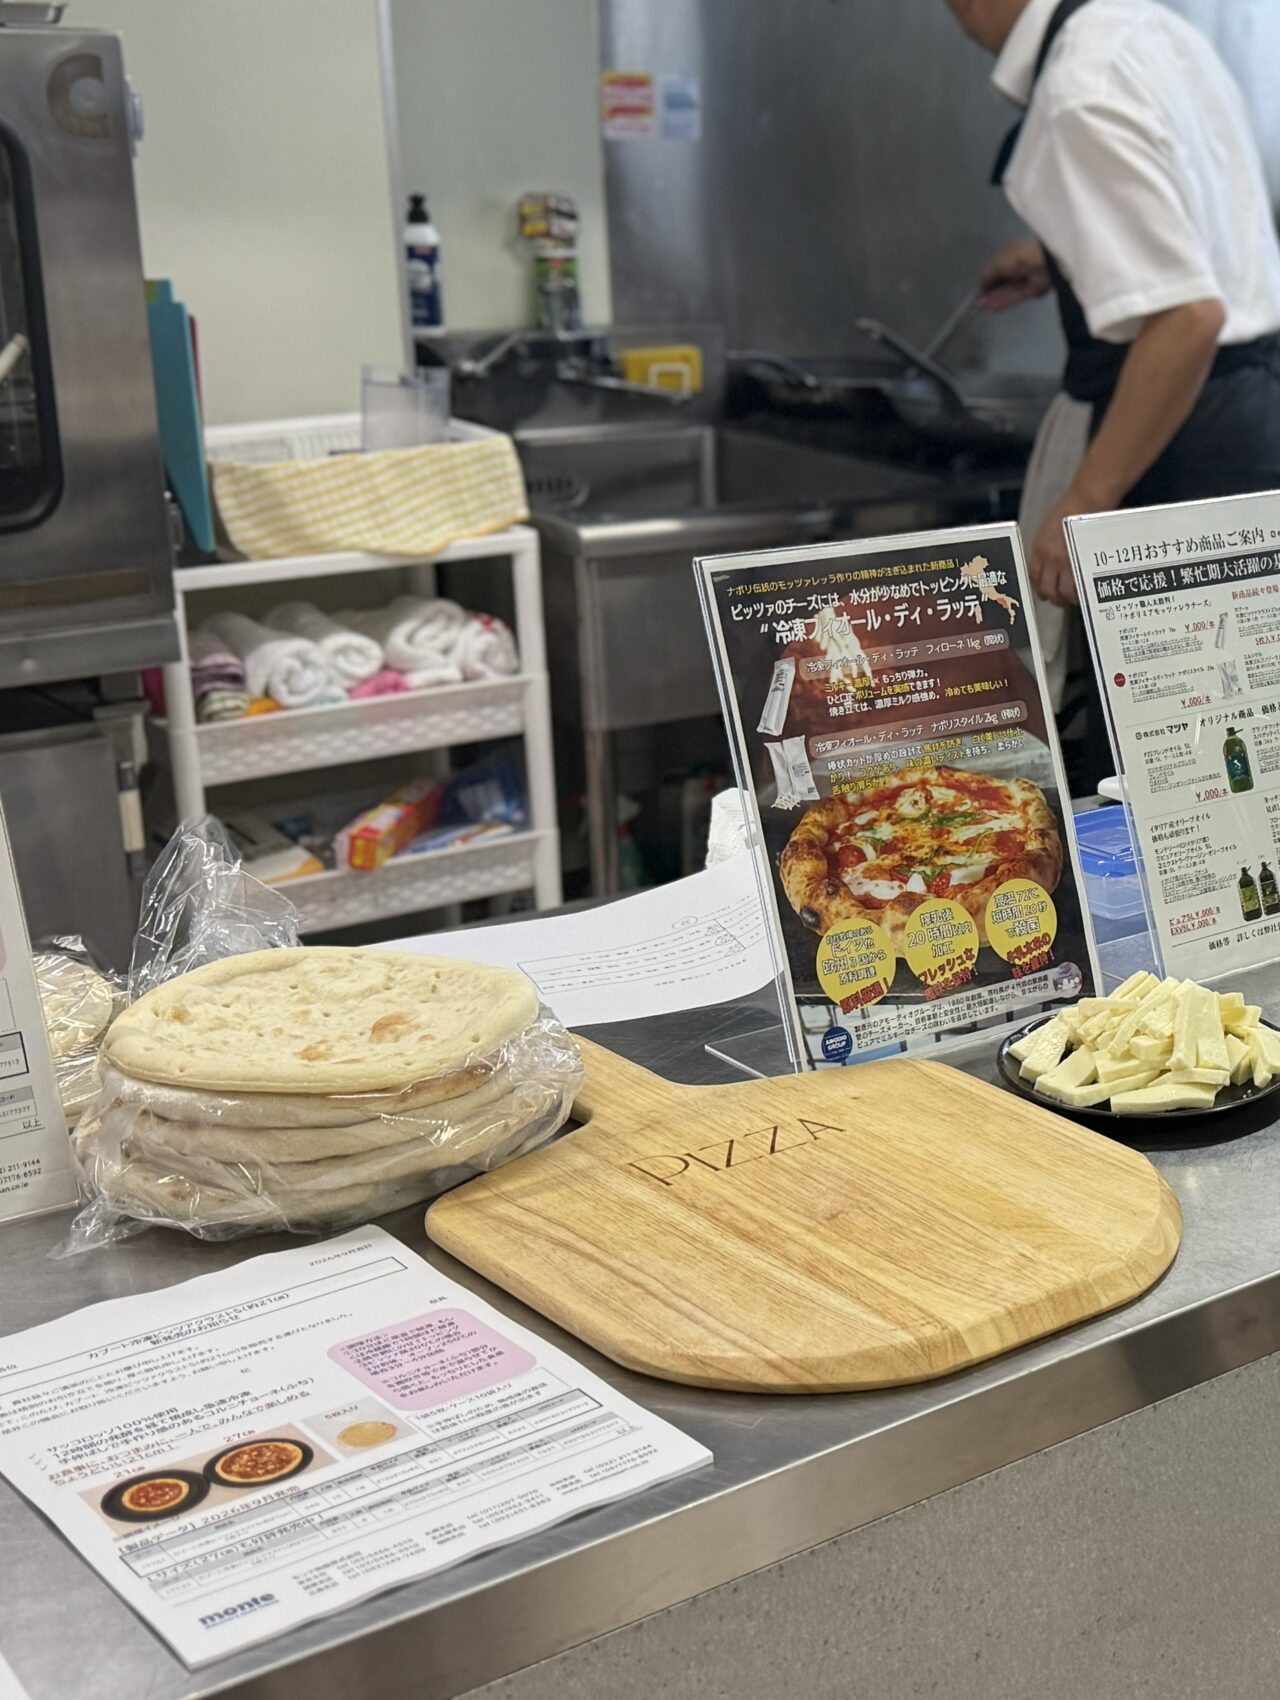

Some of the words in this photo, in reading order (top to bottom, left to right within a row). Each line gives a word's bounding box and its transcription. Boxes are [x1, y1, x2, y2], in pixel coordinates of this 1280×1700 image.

[1094, 528, 1265, 566] 10-12月おすすめ商品ご案内
[725, 557, 959, 597] ナポリ伝統のモッツァレッラ作りの精神が注ぎ込まれた新商品！
[730, 569, 1007, 622] ピッツァのチーズには、水分が少なめでトッピングに最適な
[1200, 708, 1254, 727] オリジナル商品
[23, 1118, 42, 1130] 以上
[628, 1118, 846, 1187] PIZZA
[199, 1592, 275, 1627] monte
